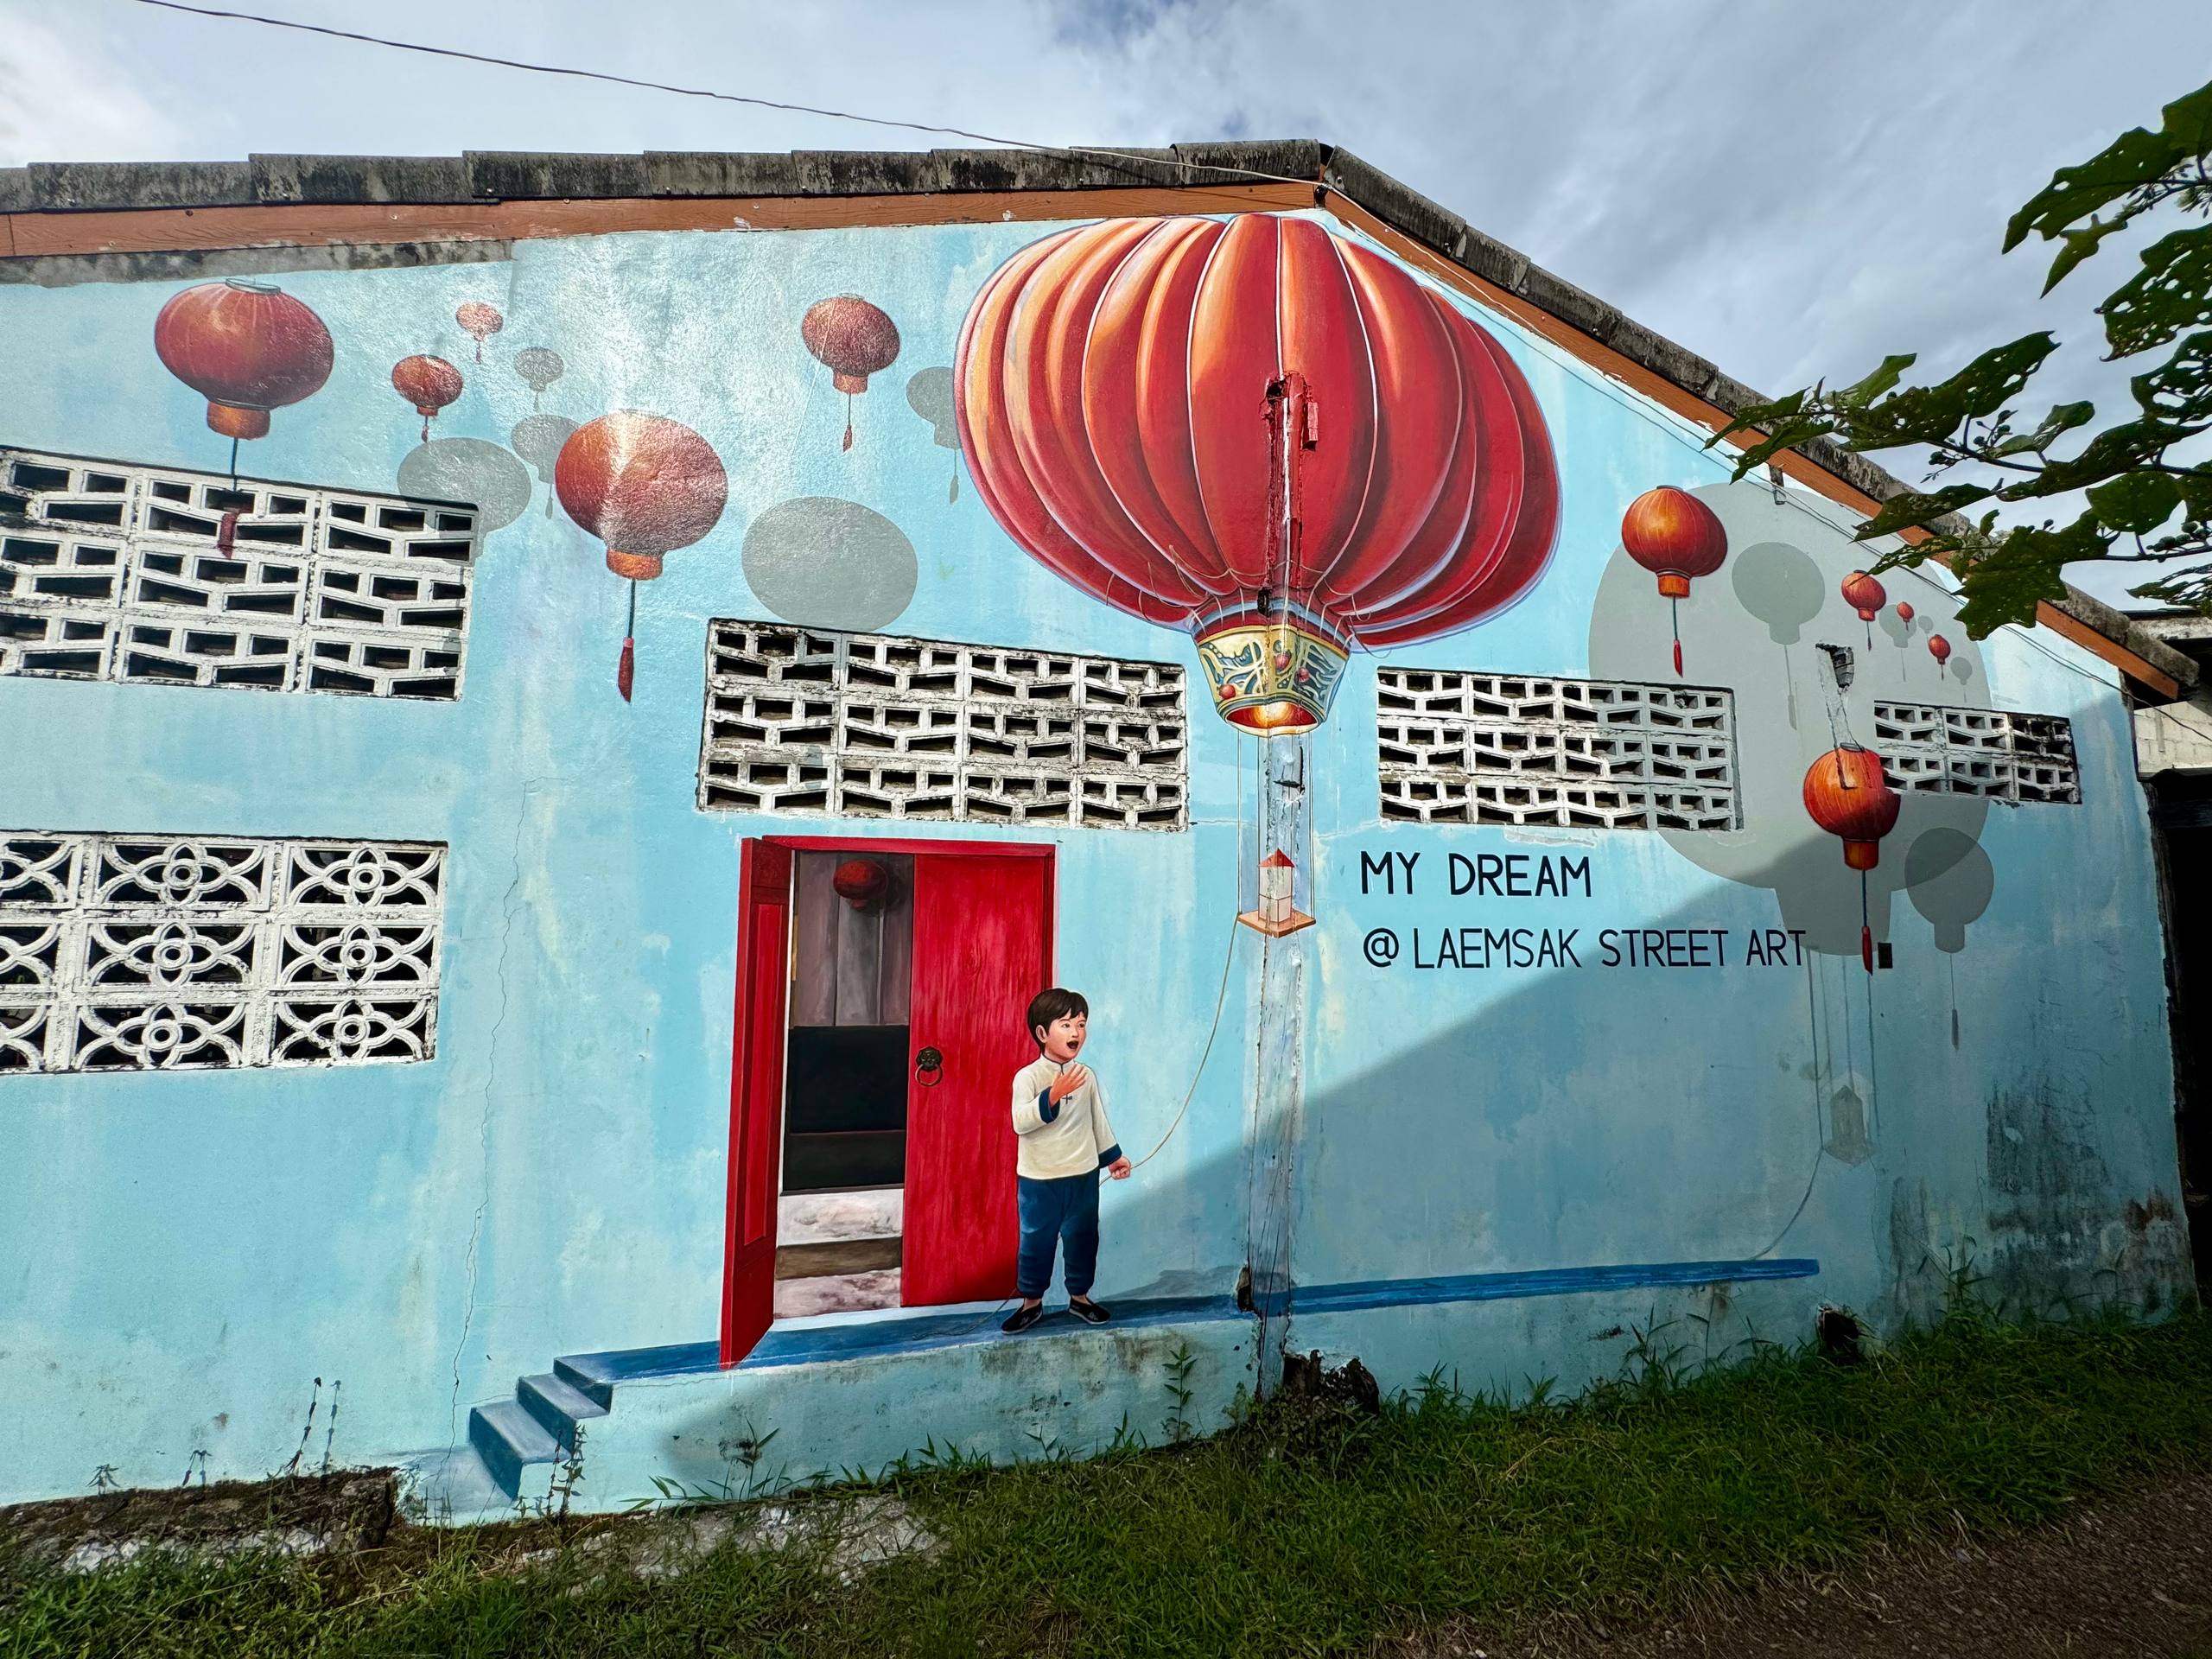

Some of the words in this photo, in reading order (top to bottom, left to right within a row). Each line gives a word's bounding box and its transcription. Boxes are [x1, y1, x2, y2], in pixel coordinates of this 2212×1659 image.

[1360, 851, 1421, 895] MY
[1449, 854, 1592, 898] DREAM
[1363, 927, 1400, 968] @
[1414, 929, 1582, 969] LAEMSAK
[1599, 929, 1729, 968] STREET
[1745, 930, 1807, 967] ART
